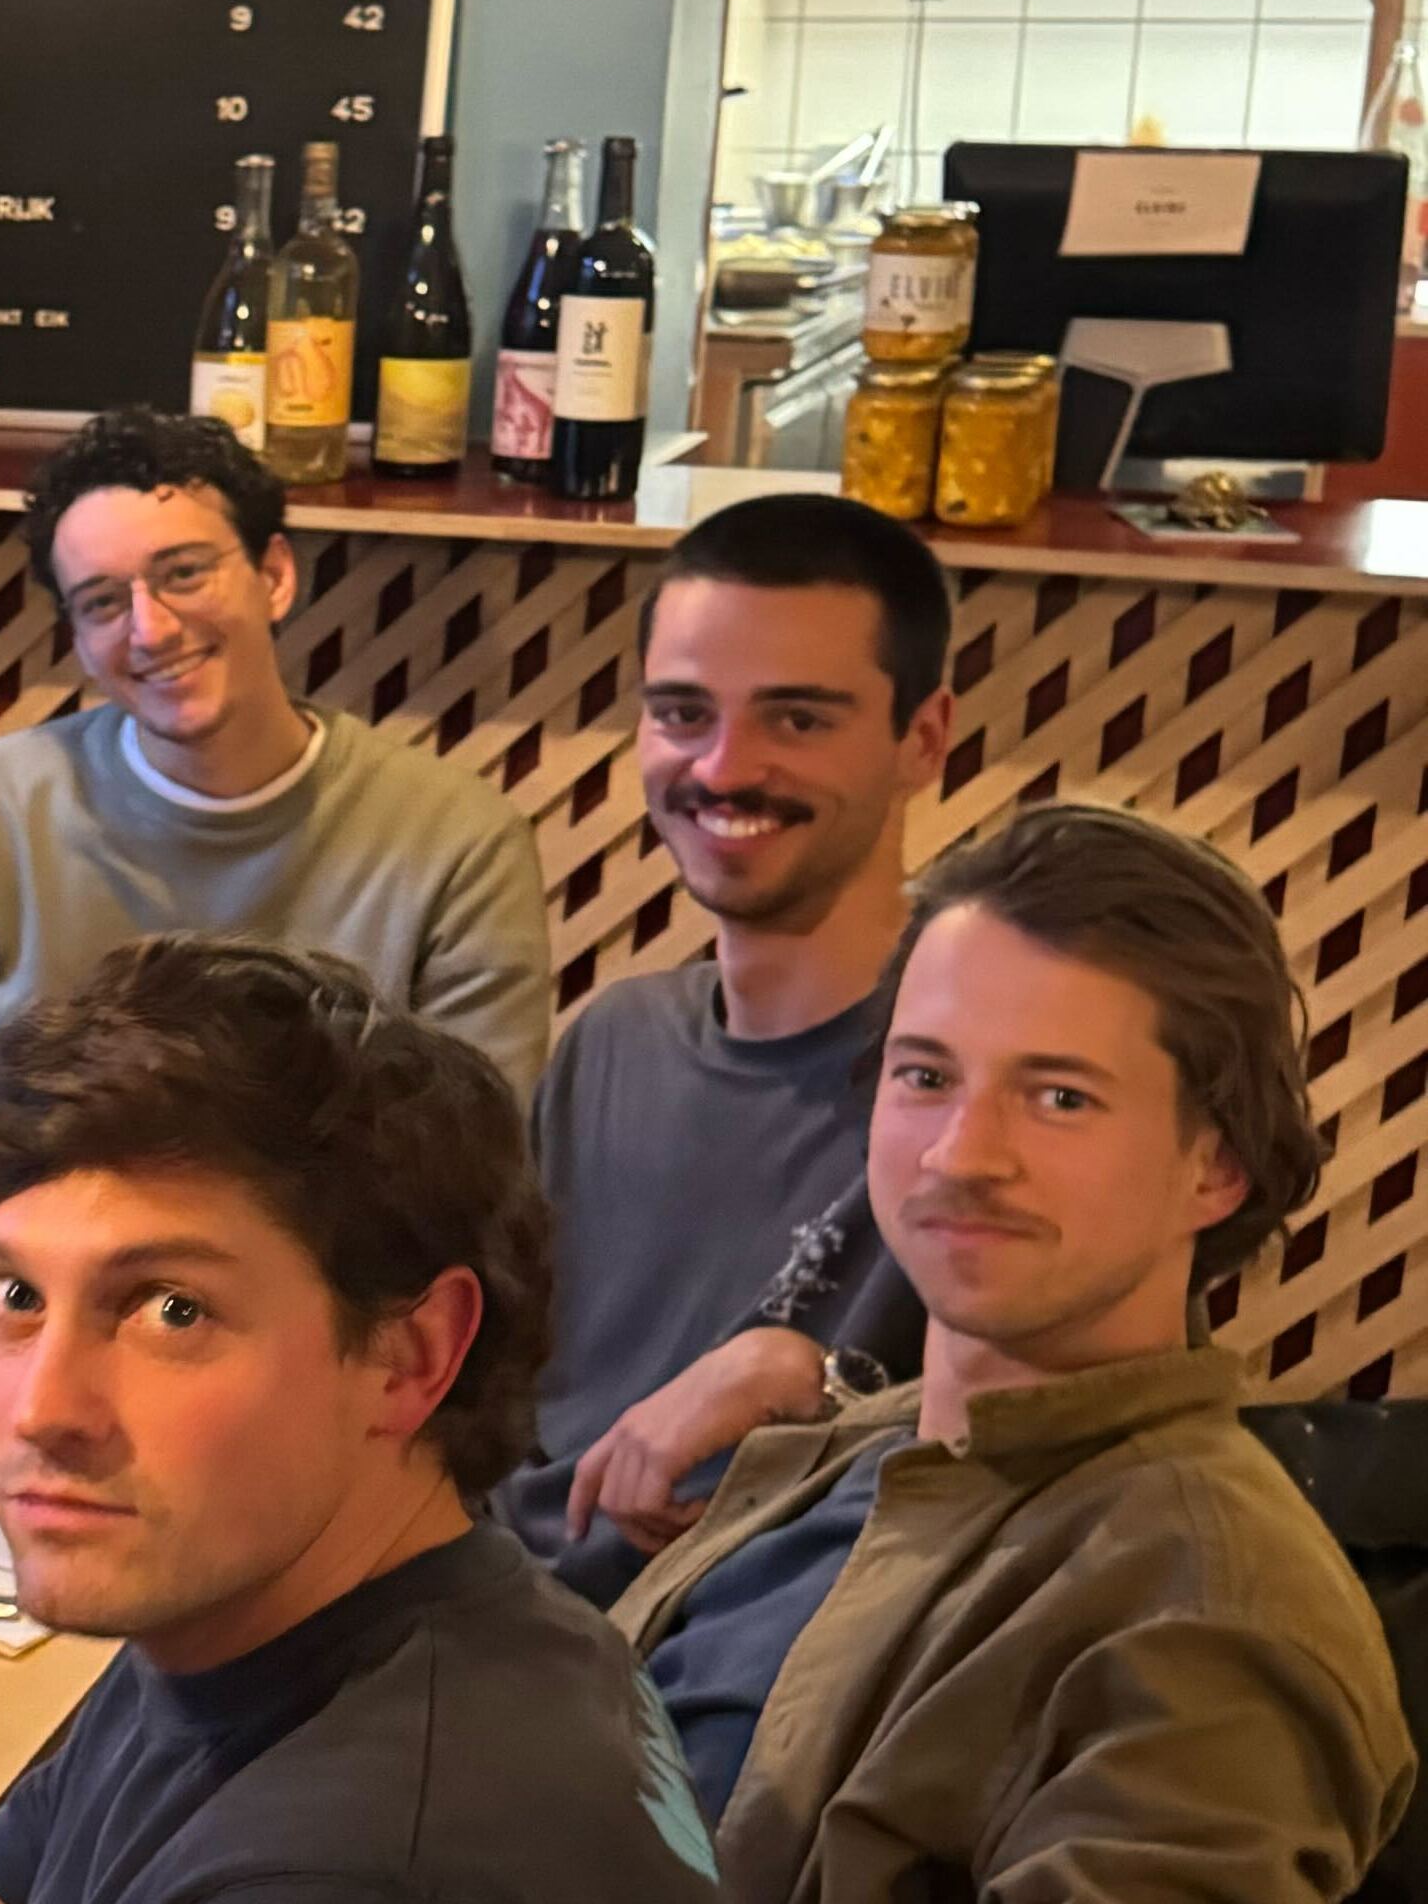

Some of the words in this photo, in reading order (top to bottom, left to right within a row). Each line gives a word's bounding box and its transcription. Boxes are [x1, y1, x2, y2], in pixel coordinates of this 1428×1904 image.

[229, 4, 253, 32] 9
[343, 4, 386, 31] 42
[216, 96, 248, 122] 10
[330, 95, 375, 122] 45
[214, 203, 237, 231] 9
